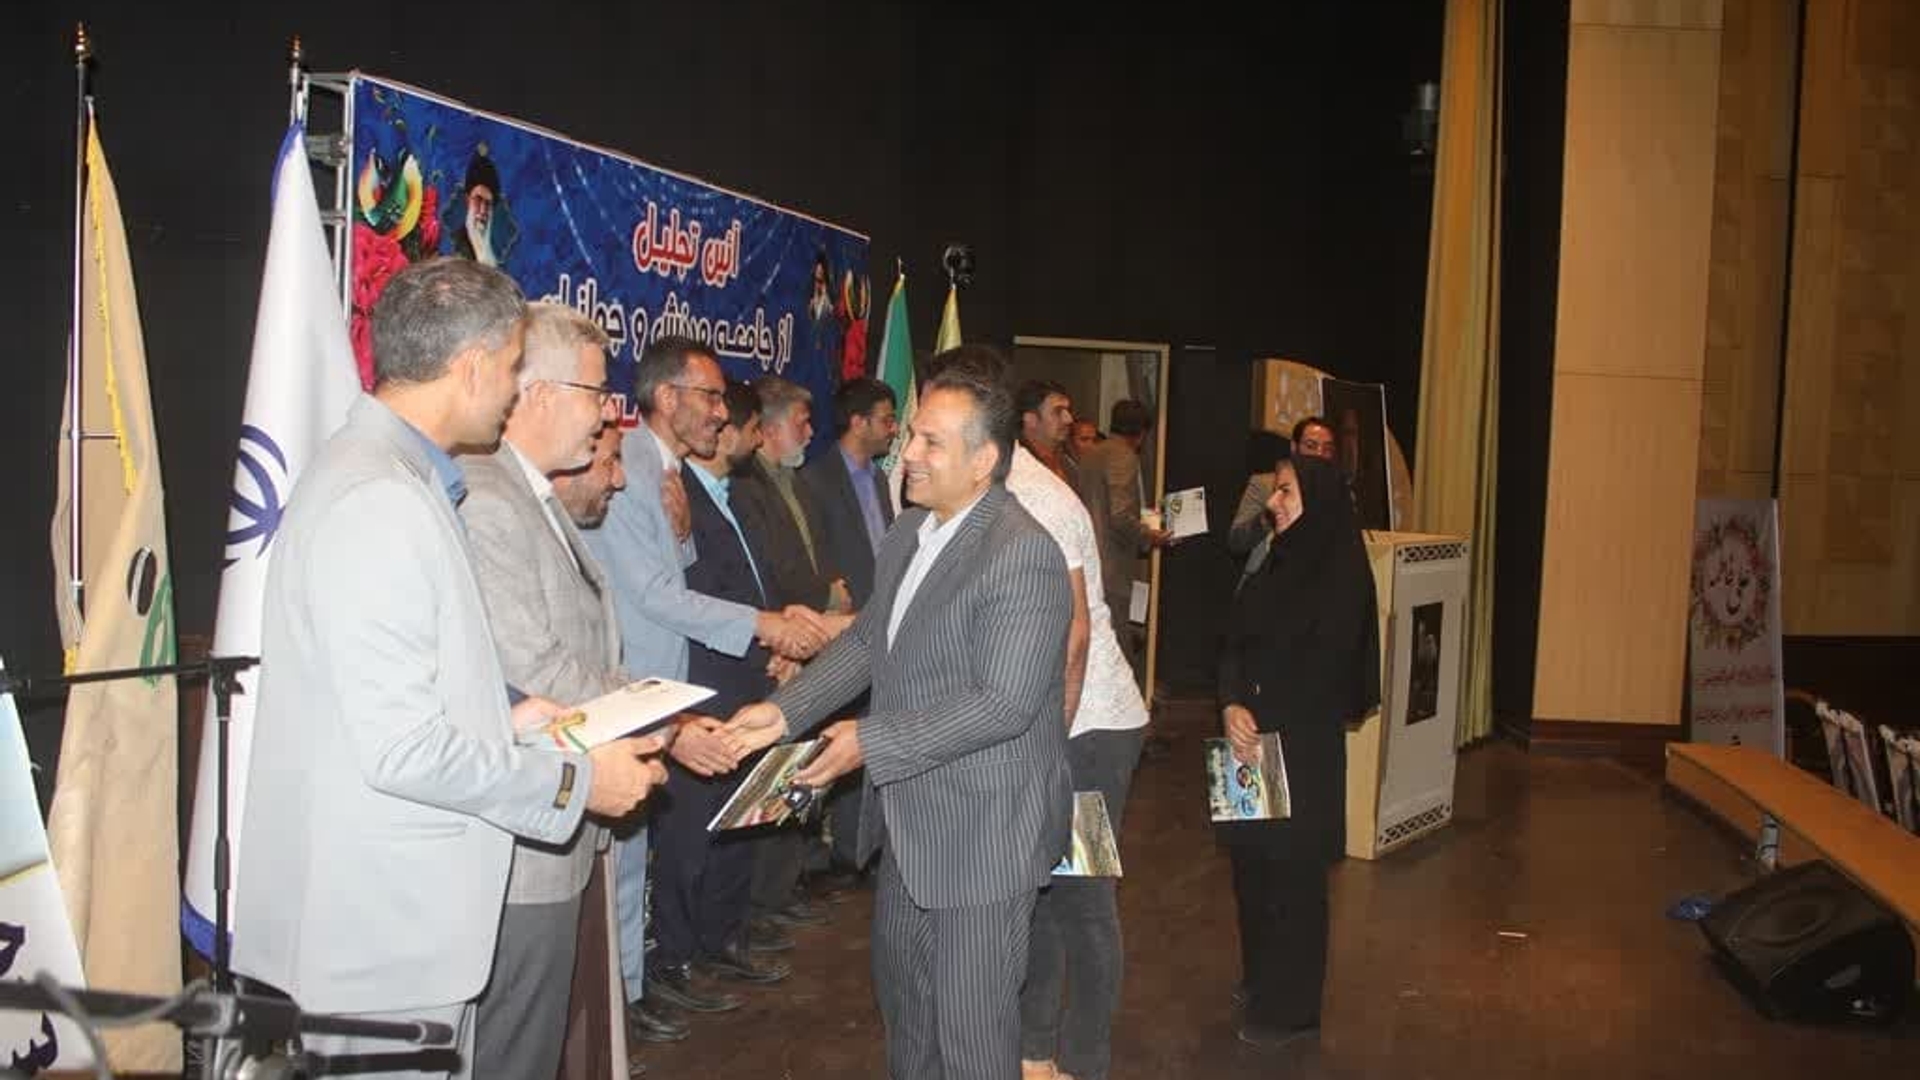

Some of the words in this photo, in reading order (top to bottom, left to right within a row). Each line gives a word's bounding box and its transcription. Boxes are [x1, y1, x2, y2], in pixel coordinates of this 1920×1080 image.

[633, 201, 700, 282] تجلیل
[540, 273, 626, 357] جوانا
[631, 307, 648, 362] و
[714, 307, 774, 371] جامعه
[775, 312, 793, 374] از
